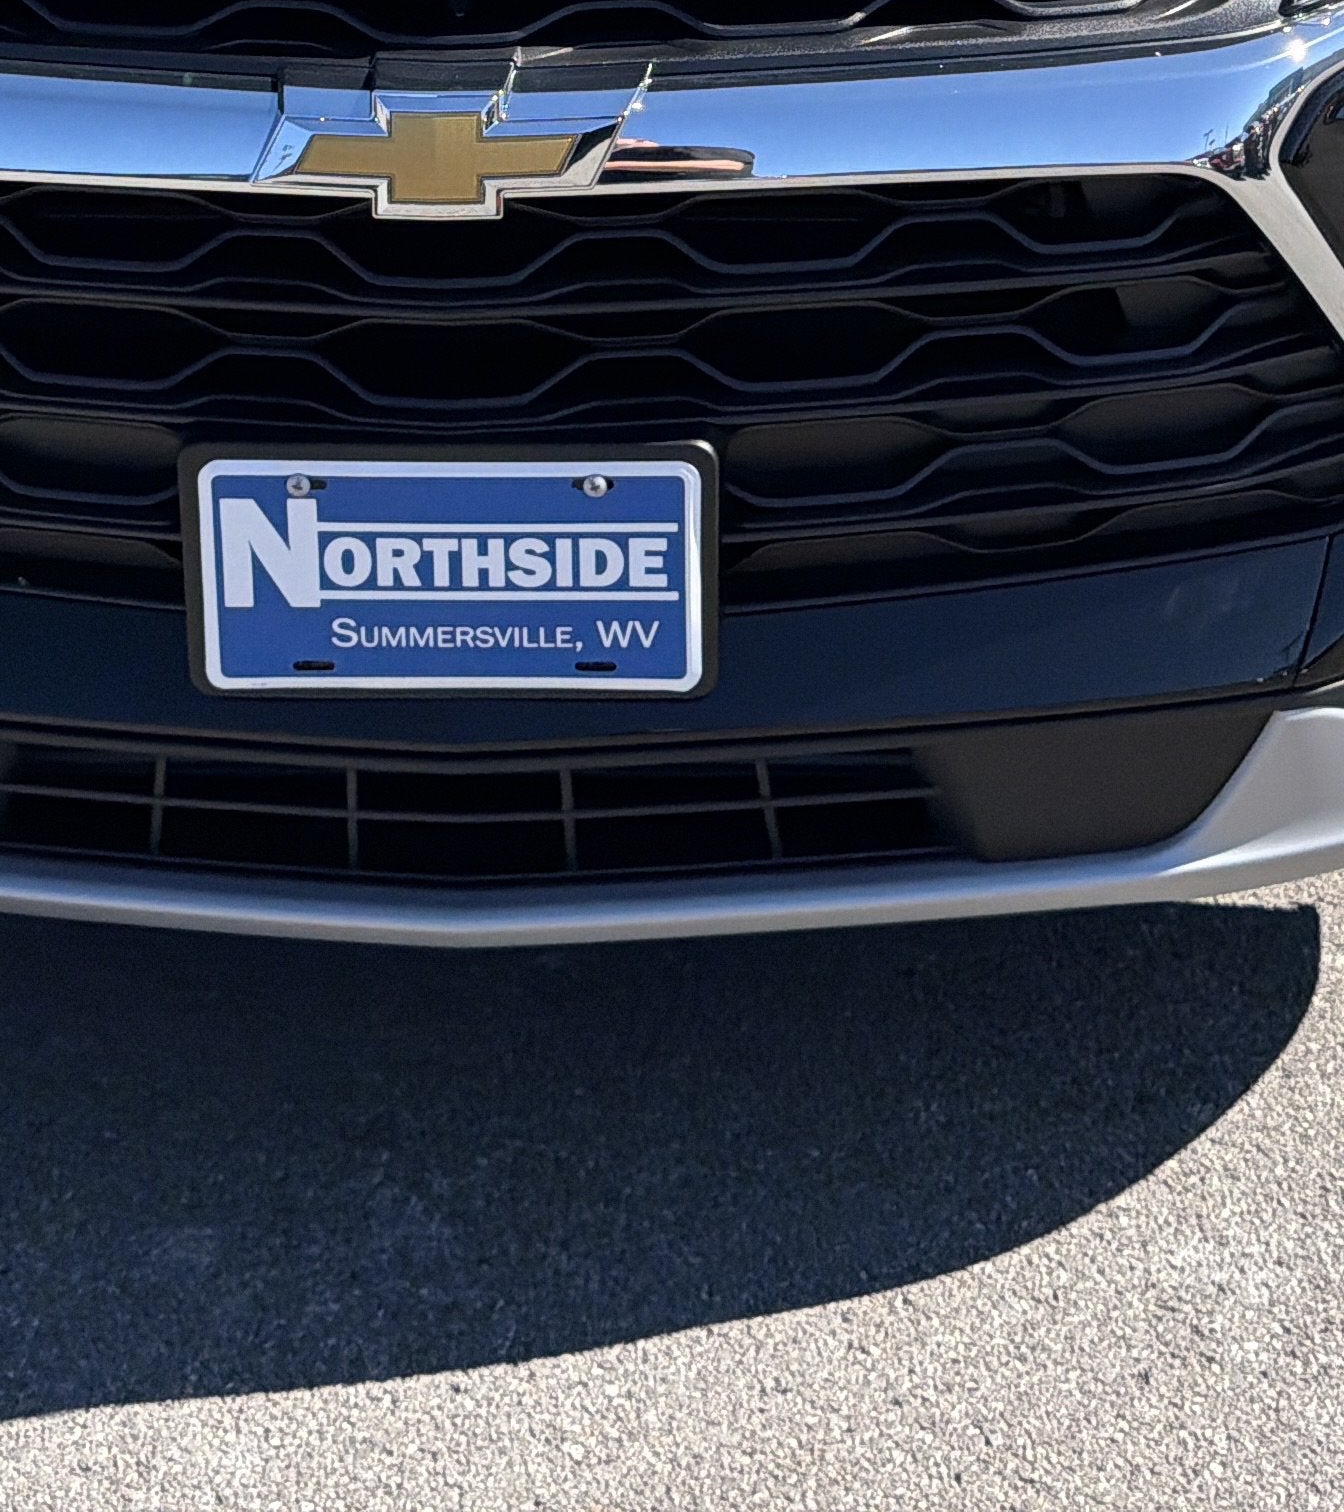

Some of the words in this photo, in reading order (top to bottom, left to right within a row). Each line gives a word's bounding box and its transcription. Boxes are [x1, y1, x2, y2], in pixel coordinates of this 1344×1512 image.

[218, 497, 668, 608] NORTHSIDE
[330, 617, 584, 652] SUMMERSVILLE,
[596, 619, 660, 648] WV
